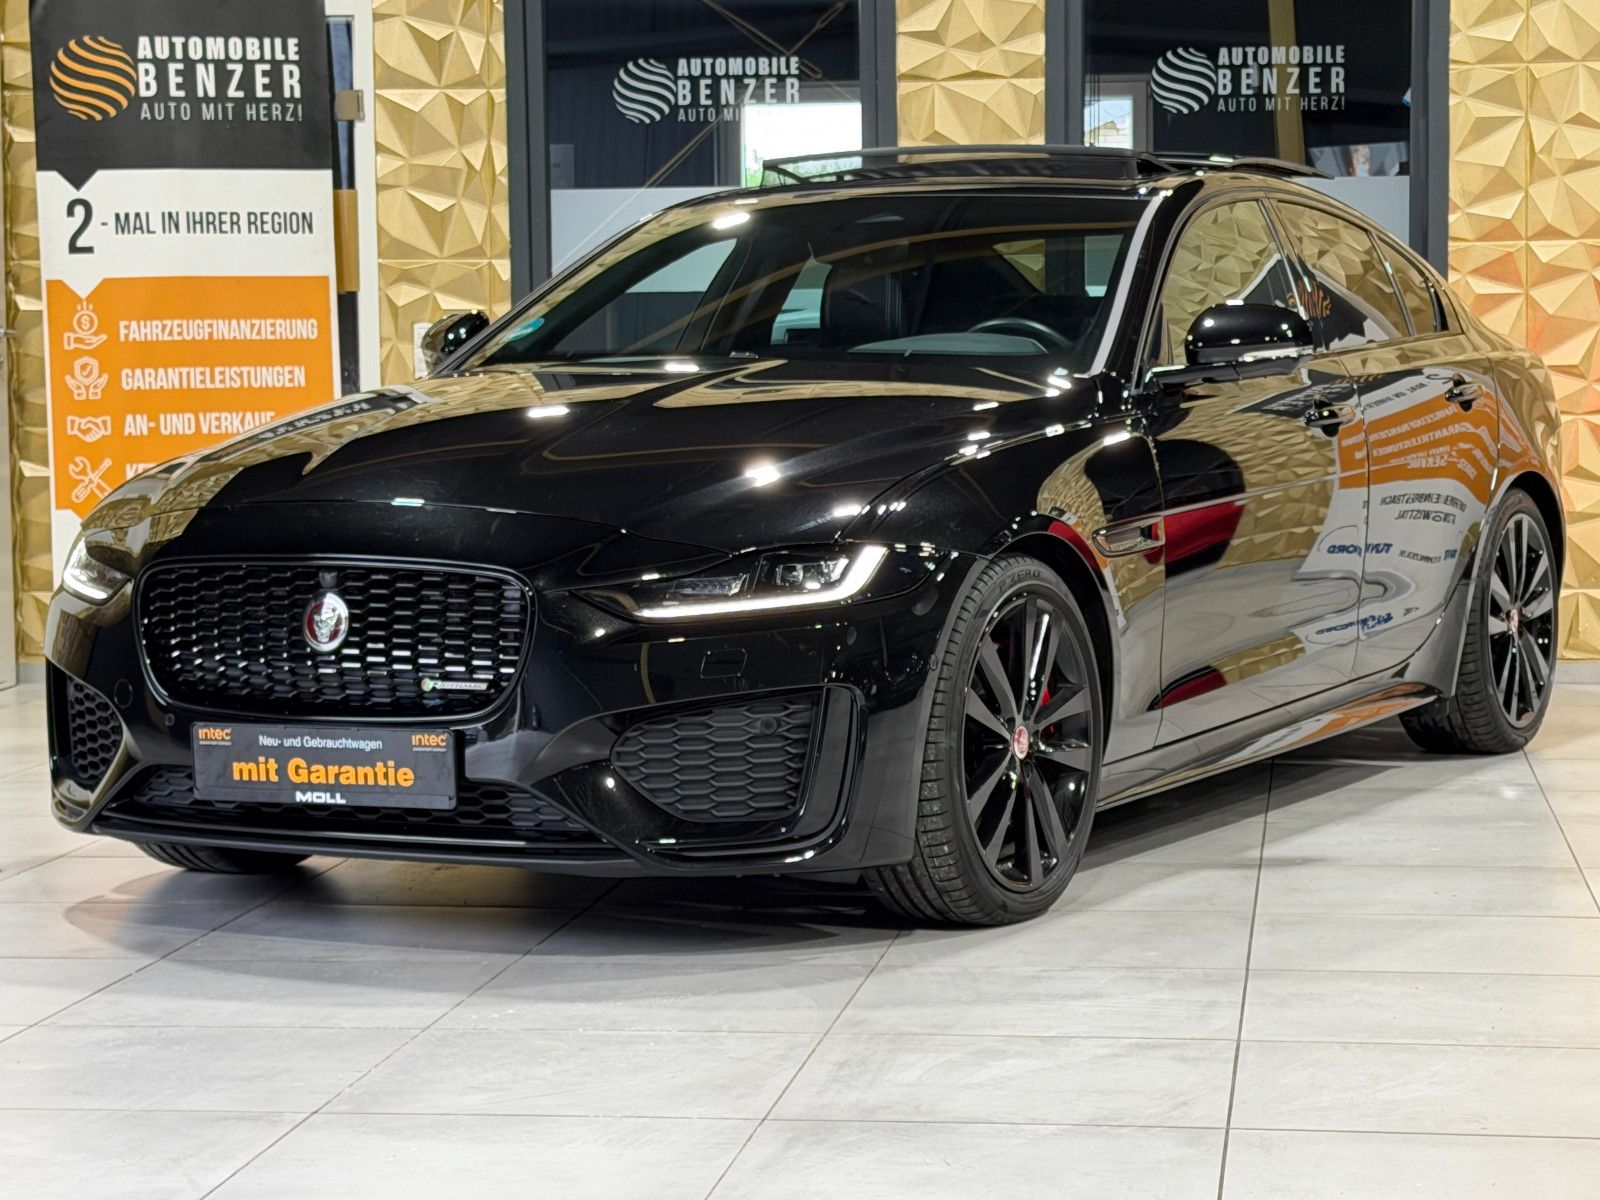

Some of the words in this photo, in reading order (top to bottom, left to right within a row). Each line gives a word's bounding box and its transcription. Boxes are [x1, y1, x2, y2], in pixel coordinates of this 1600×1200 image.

[137, 36, 300, 60] AUTOMOBILE
[1217, 45, 1346, 66] AUTOMOBILE
[677, 57, 800, 77] AUTOMOBILE
[138, 63, 302, 98] BENZER
[1217, 67, 1346, 96] BENZER
[677, 78, 800, 106] BENZER
[140, 103, 191, 121] AUTO
[201, 104, 235, 121] MIT
[246, 104, 303, 122] HERZ!
[677, 108, 716, 122] AUTO
[1217, 97, 1257, 112] AUTO
[1265, 97, 1292, 111] MIT
[1301, 96, 1346, 111] HERZ!
[66, 198, 94, 255] 2
[114, 212, 156, 235] MAL
[161, 212, 179, 235] IN
[186, 212, 240, 235] IHRER
[247, 211, 313, 235] REGION
[119, 318, 318, 342] FAHRZEUGFINANZIERUNG
[121, 366, 306, 390] GARANTIELEISTUNGEN
[124, 414, 156, 436] AN-
[160, 413, 196, 435] UND
[198, 727, 232, 741] intec
[259, 734, 282, 748] Neu-
[283, 736, 301, 748] und
[303, 735, 383, 751] Gebrauchtwagen
[411, 732, 448, 748] intec
[232, 756, 279, 783] mit
[287, 757, 415, 788] Garantie
[295, 790, 346, 805] MOLL
